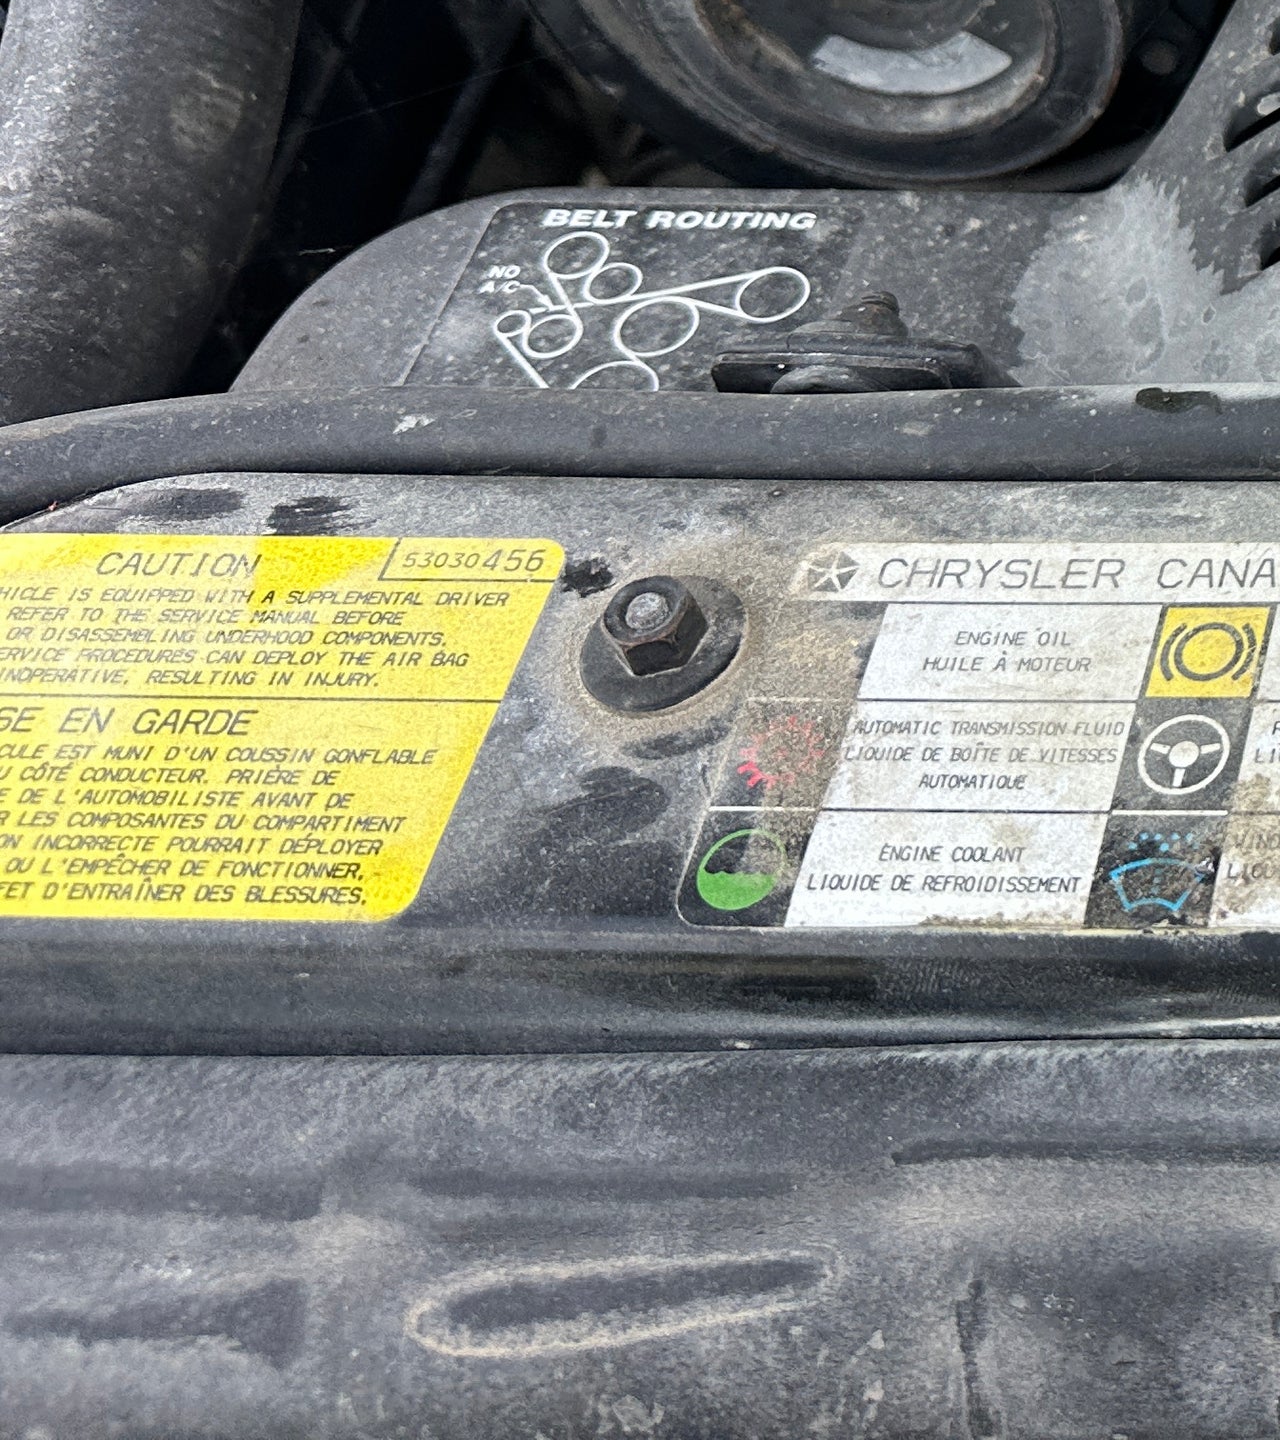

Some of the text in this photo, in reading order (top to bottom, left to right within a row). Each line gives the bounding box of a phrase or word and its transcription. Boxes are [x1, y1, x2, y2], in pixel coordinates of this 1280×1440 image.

[542, 208, 818, 231] BELT ROUTING
[488, 265, 521, 279] NO
[96, 553, 263, 577] CAUTION
[402, 549, 546, 572] 53030456
[877, 559, 1126, 589] CHRYSLER
[68, 588, 510, 606] IS EQUIPPED WITH A SUPPLEMENTAL DRIVER
[954, 631, 1071, 647] ENGINE OIL
[76, 649, 470, 667] PROCEDURES CAN DEPLOY THE AIR BAG
[922, 650, 1092, 673] HUILE À MOTEUR
[145, 670, 378, 687] RESULTING IN INJURY.
[58, 708, 259, 735] EN GARDE
[852, 720, 1125, 736] AUTOMATIC TRANSMISSION FLUID
[921, 747, 944, 763] DE
[949, 742, 1001, 762] BOÎTE
[1008, 747, 1030, 763] DE
[1039, 748, 1118, 765] VITESSES
[918, 774, 1028, 790] AUTOMATIQUE
[33, 833, 384, 855] INCORRECTE POURRAIT DÉPLOYER
[878, 844, 1026, 863] ENGINE COOLANT
[5, 857, 35, 873] OU
[41, 854, 172, 875] L'EMPÊCHER
[179, 860, 209, 876] DE
[42, 878, 186, 901] D'ENTRAÎNER
[194, 885, 236, 902] DES
[806, 874, 1082, 893] LIQUIDE DE REFROIDISSEMENT
